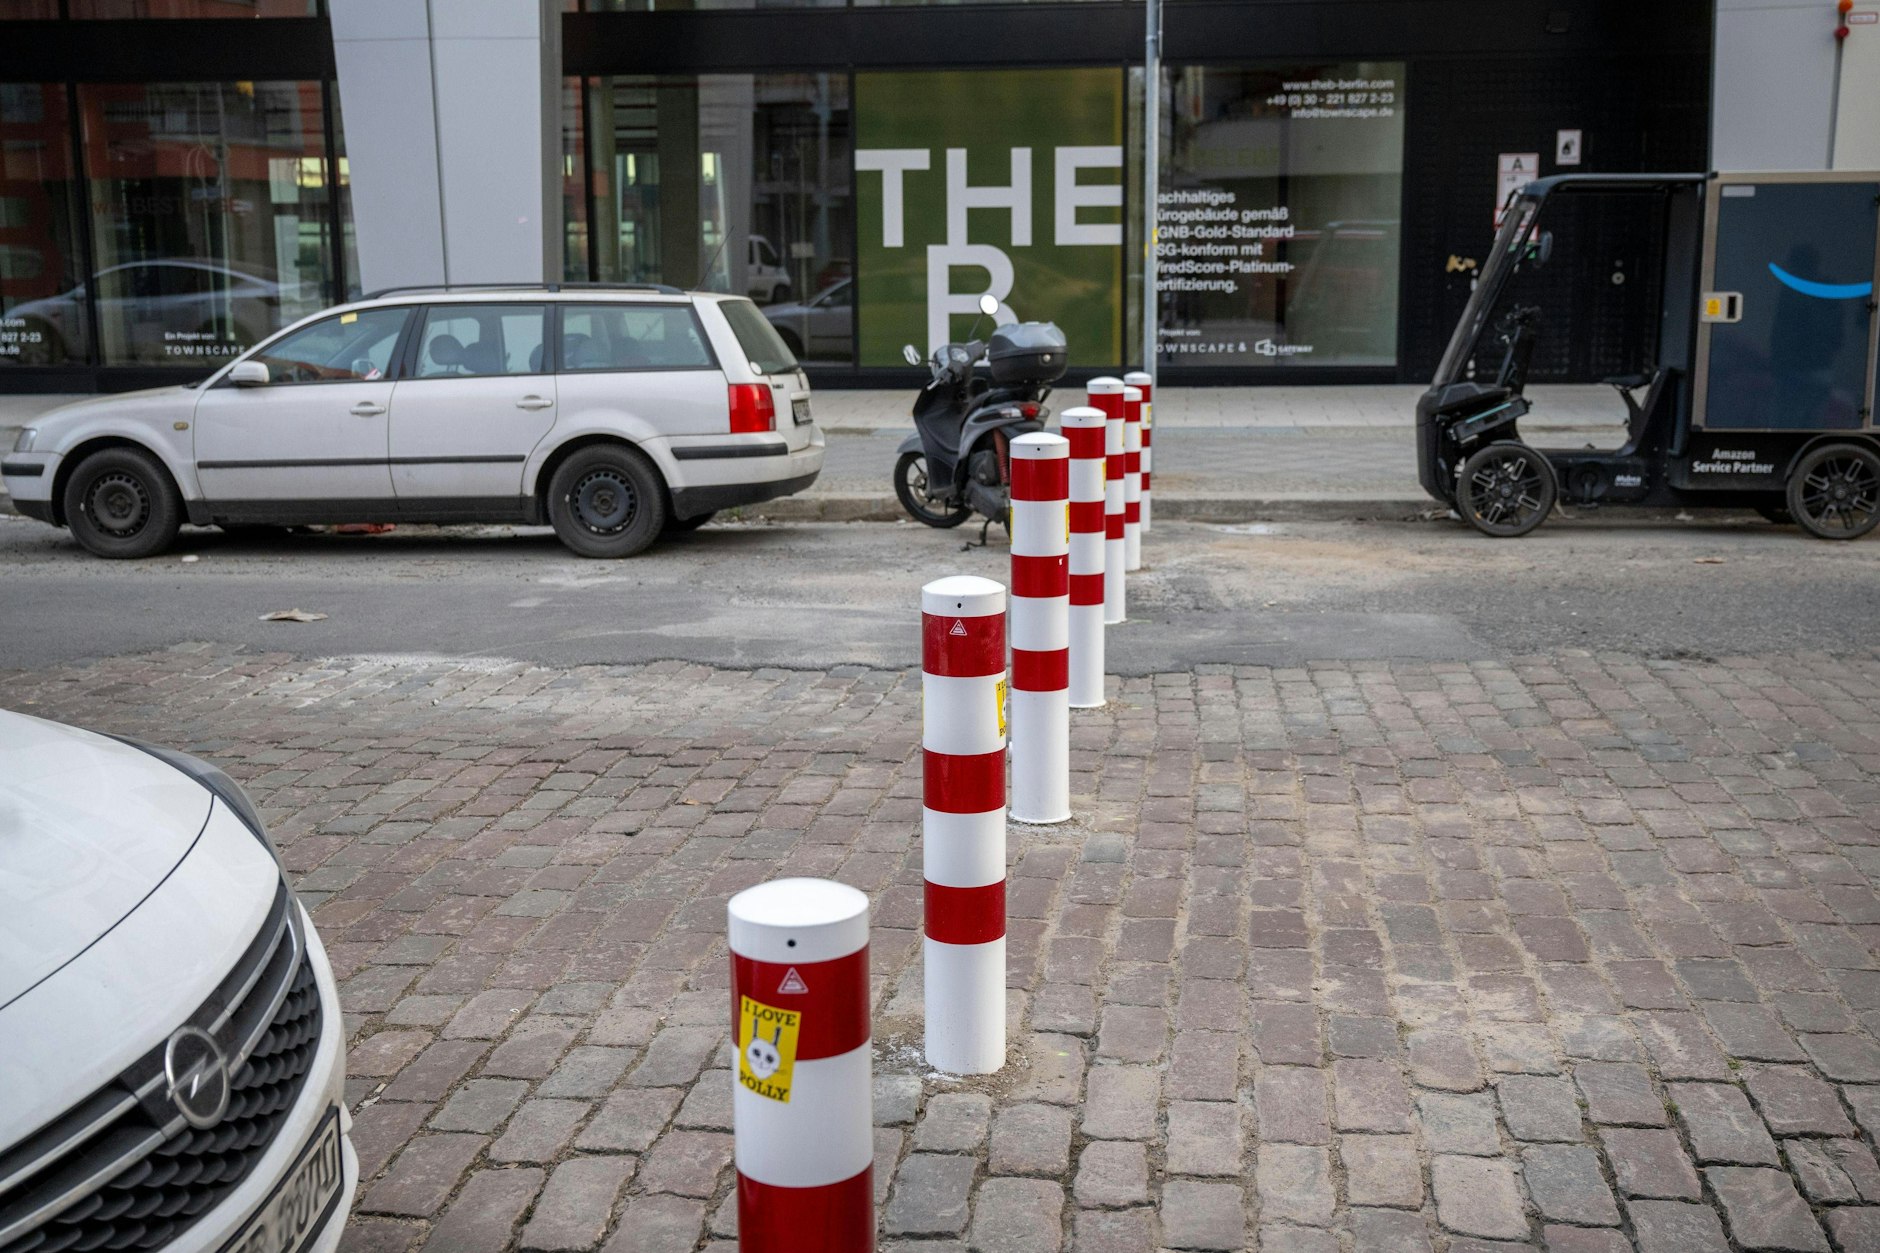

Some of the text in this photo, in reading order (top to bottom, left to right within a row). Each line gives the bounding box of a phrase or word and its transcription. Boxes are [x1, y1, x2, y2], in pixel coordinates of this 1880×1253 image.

[1282, 79, 1394, 91] www.theb-berlin.com
[1303, 93, 1318, 105] 30
[1326, 93, 1345, 104] 221
[1291, 107, 1394, 119] info@townscape.de
[1512, 156, 1523, 171] A
[855, 146, 1123, 247] THE
[1157, 190, 1236, 206] achhaltiges
[1157, 206, 1288, 223] ürogebäude gemäß
[1157, 224, 1295, 238] GNB-Gold-Standard
[1156, 242, 1263, 256] SG-konform mit
[1156, 278, 1238, 294] ertifizierung.
[927, 244, 1019, 367] B
[176, 331, 200, 341] Projekt
[1158, 328, 1184, 337] Projekt
[164, 345, 245, 355] TOWNSCAPE
[1156, 343, 1235, 353] OWNSCAPE
[1712, 448, 1755, 460] Amazon
[1692, 461, 1774, 473] Service Partner
[743, 1001, 797, 1026] I LOVE
[740, 1070, 788, 1101] POLLY
